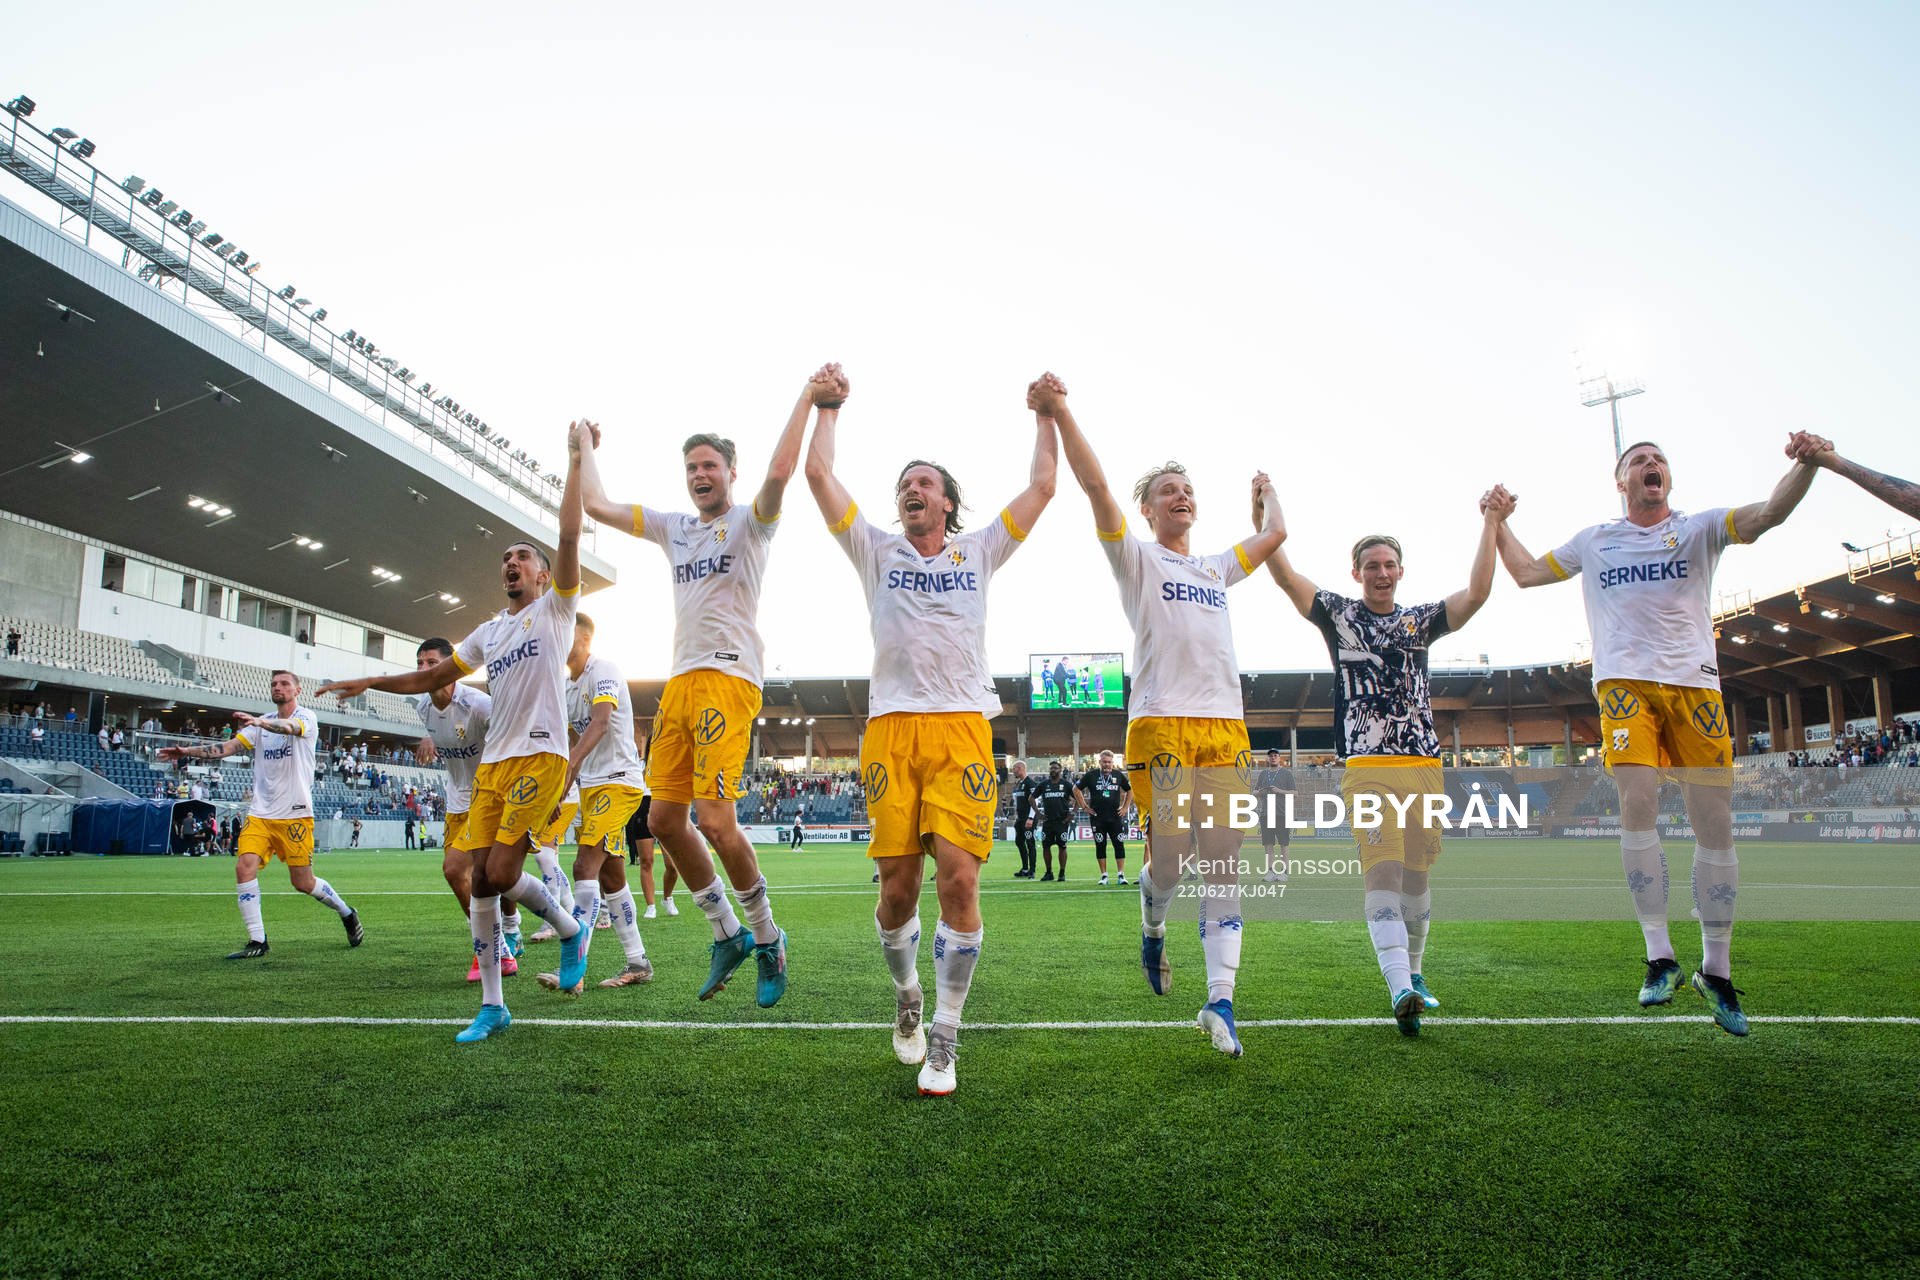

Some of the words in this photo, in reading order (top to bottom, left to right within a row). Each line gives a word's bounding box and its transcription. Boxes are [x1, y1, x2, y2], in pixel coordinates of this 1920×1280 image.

[888, 569, 977, 593] SERNEKE
[1599, 559, 1689, 590] SERNEKE
[975, 813, 990, 834] 13
[803, 832, 838, 841] Ventilation
